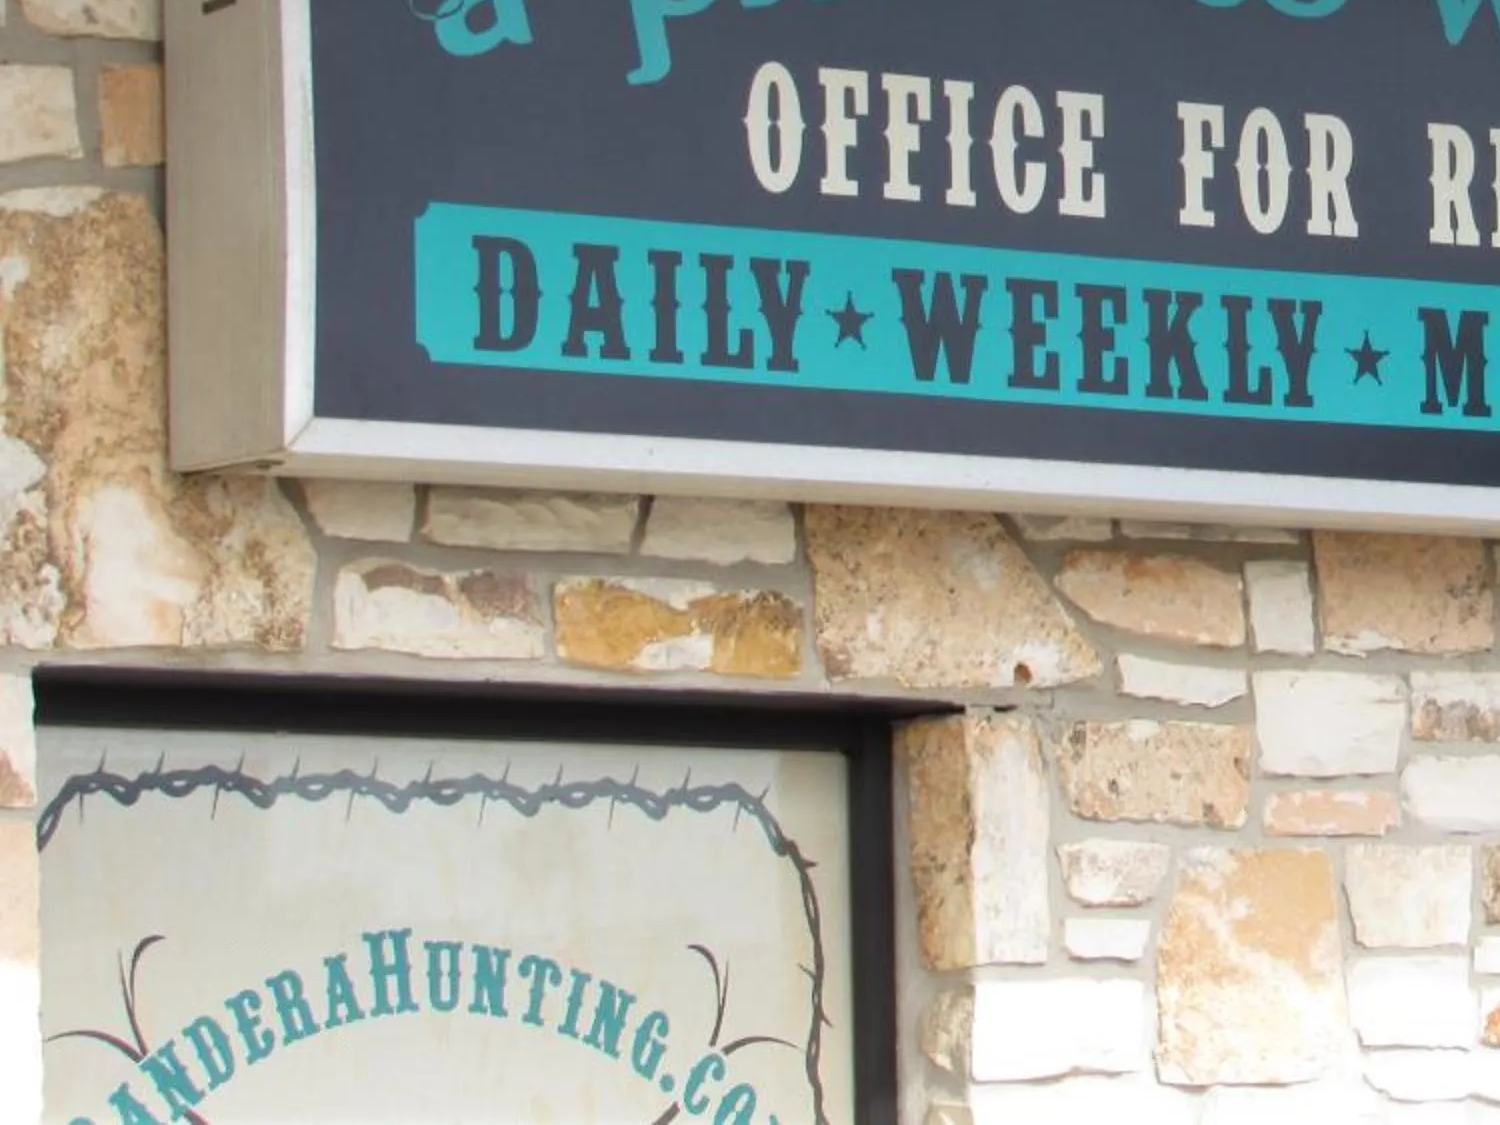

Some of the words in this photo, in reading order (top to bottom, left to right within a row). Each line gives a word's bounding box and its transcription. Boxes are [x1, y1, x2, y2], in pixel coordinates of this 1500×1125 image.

[743, 61, 1107, 219] OFFICE
[1177, 101, 1360, 238] FOR
[471, 234, 812, 375] DAILY
[890, 267, 1324, 409] WEEKLY
